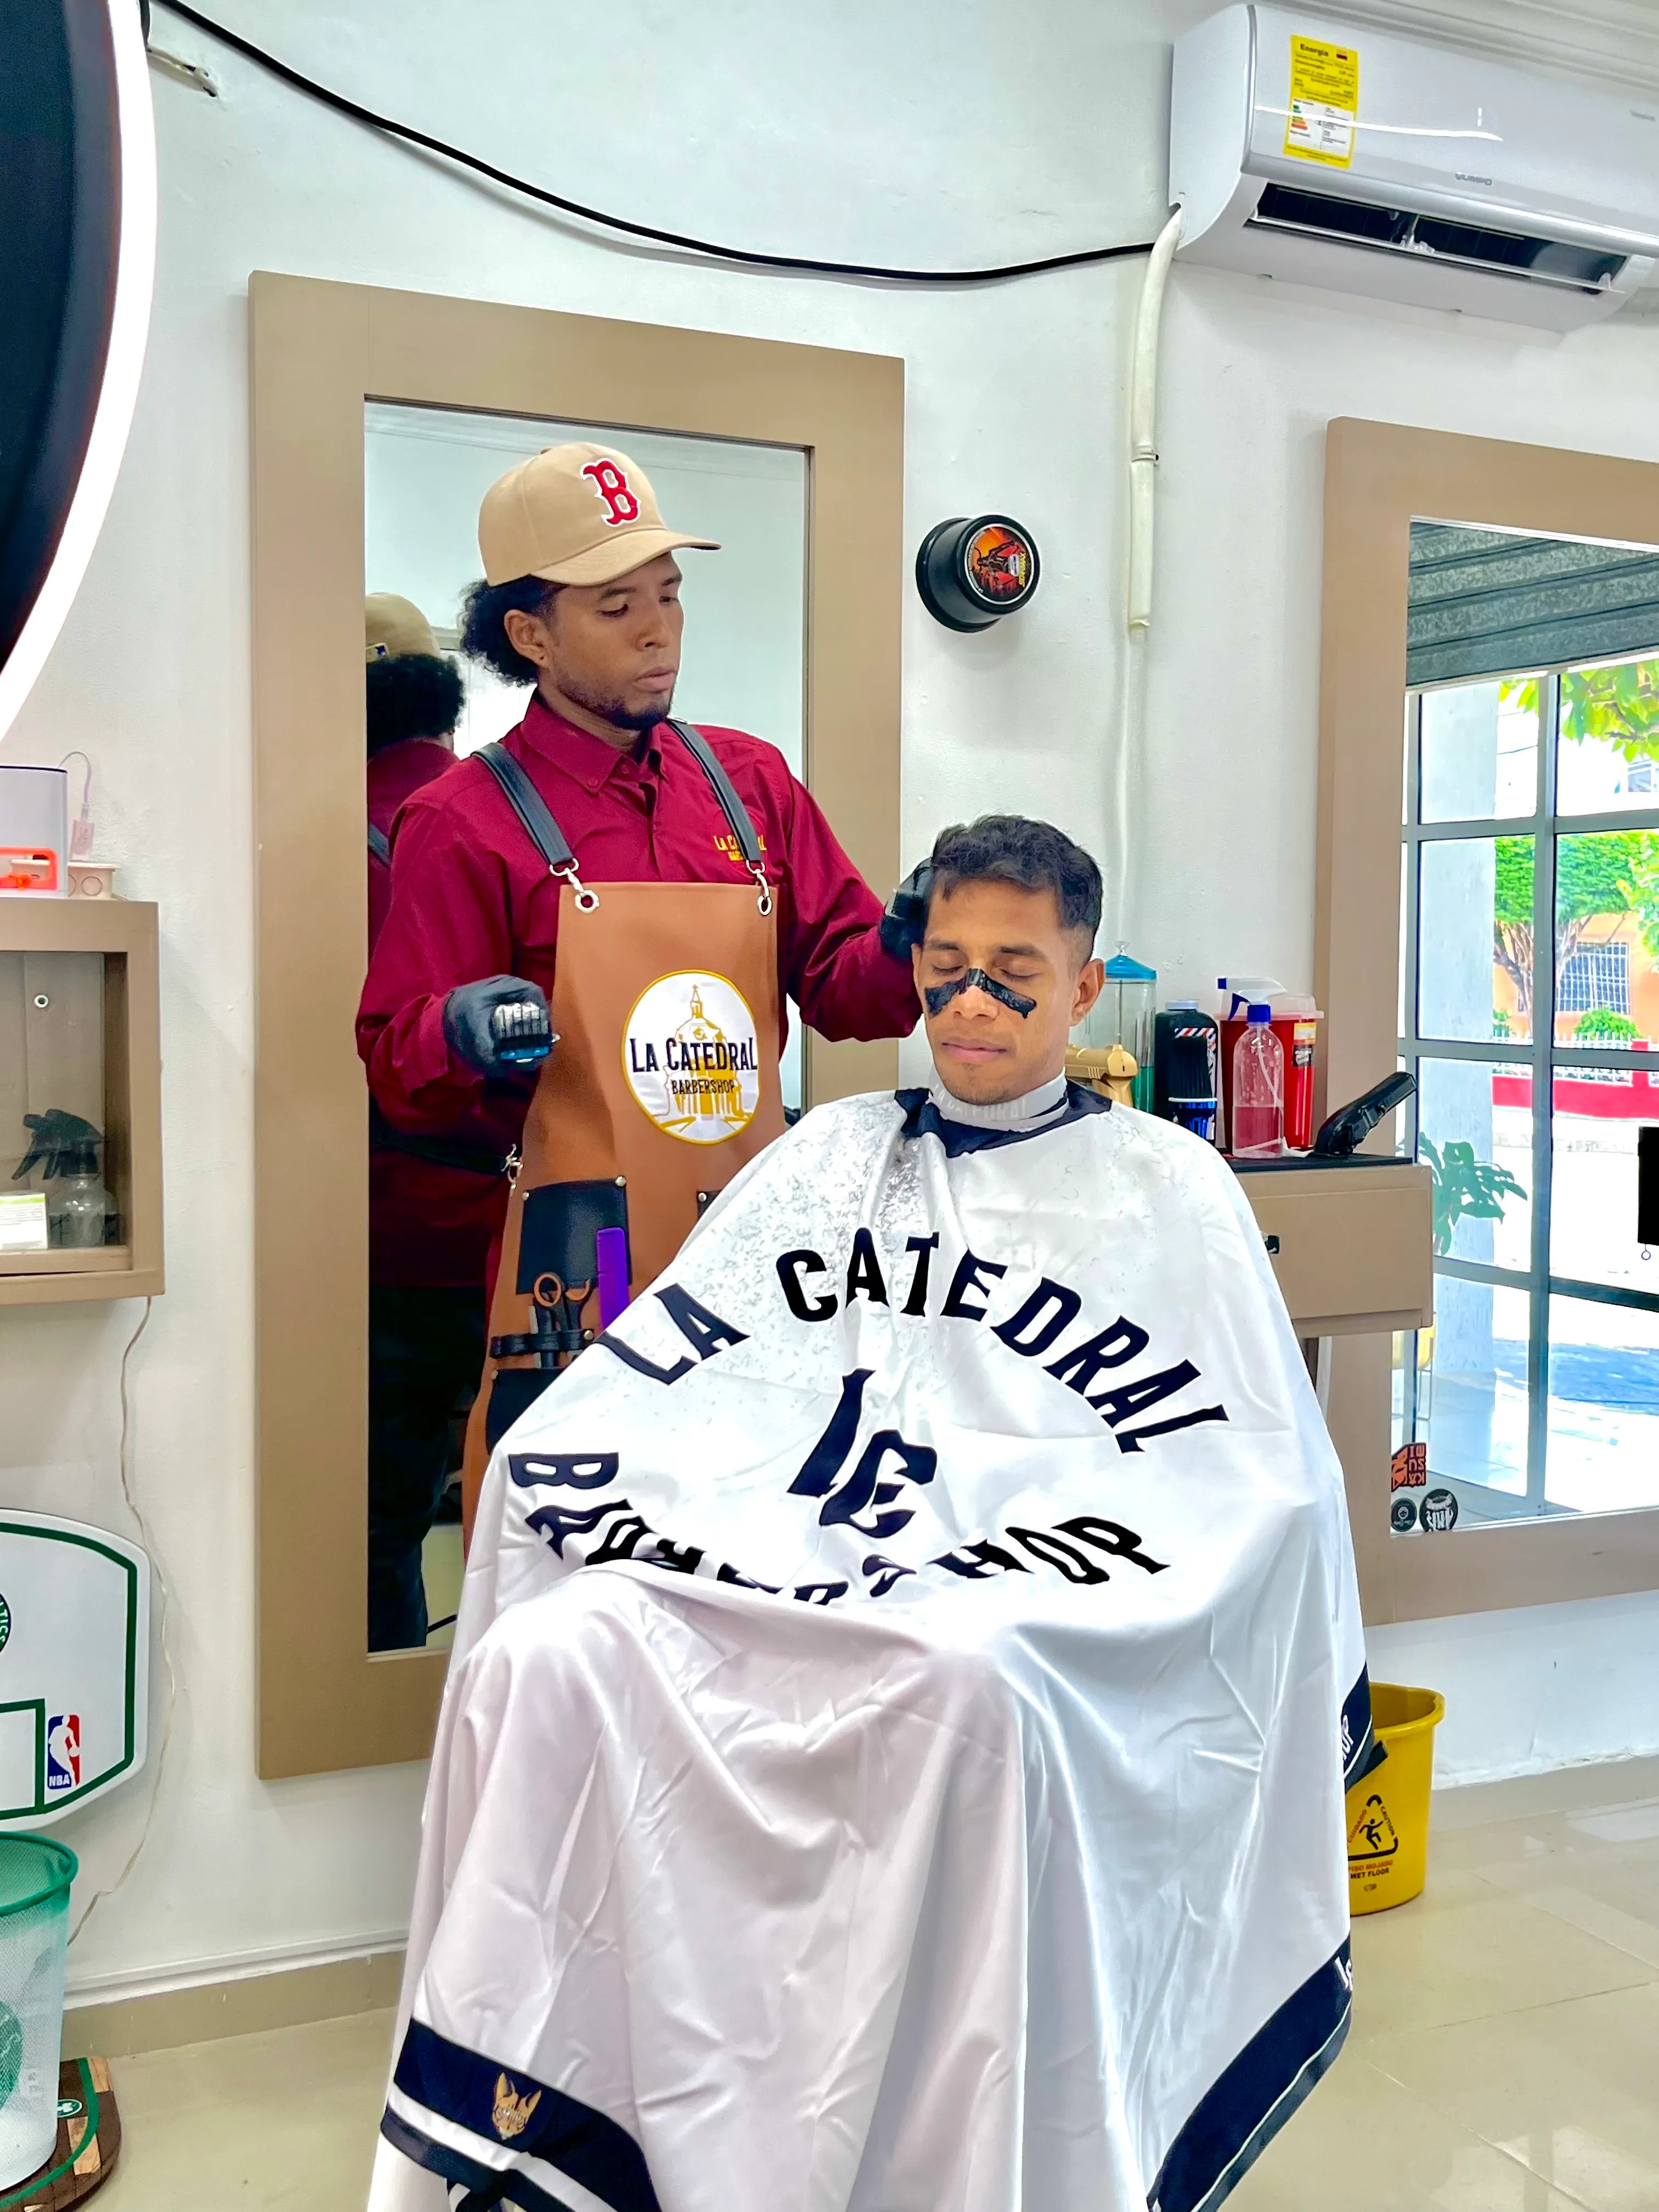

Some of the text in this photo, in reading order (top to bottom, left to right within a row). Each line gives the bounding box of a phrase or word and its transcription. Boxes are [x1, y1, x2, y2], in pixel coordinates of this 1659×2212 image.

[581, 458, 642, 527] B
[630, 1037, 758, 1073] LA CATEDRAL
[671, 1079, 735, 1094] BARBERSHOP
[597, 1227, 1229, 1454] LA CATEDRAL
[49, 1774, 70, 1787] NBA
[1347, 1809, 1367, 1843] CUIDADO
[1380, 1806, 1396, 1837] CAUTION
[1366, 1859, 1393, 1870] MOJADO
[1368, 1867, 1390, 1877] FLOOR
